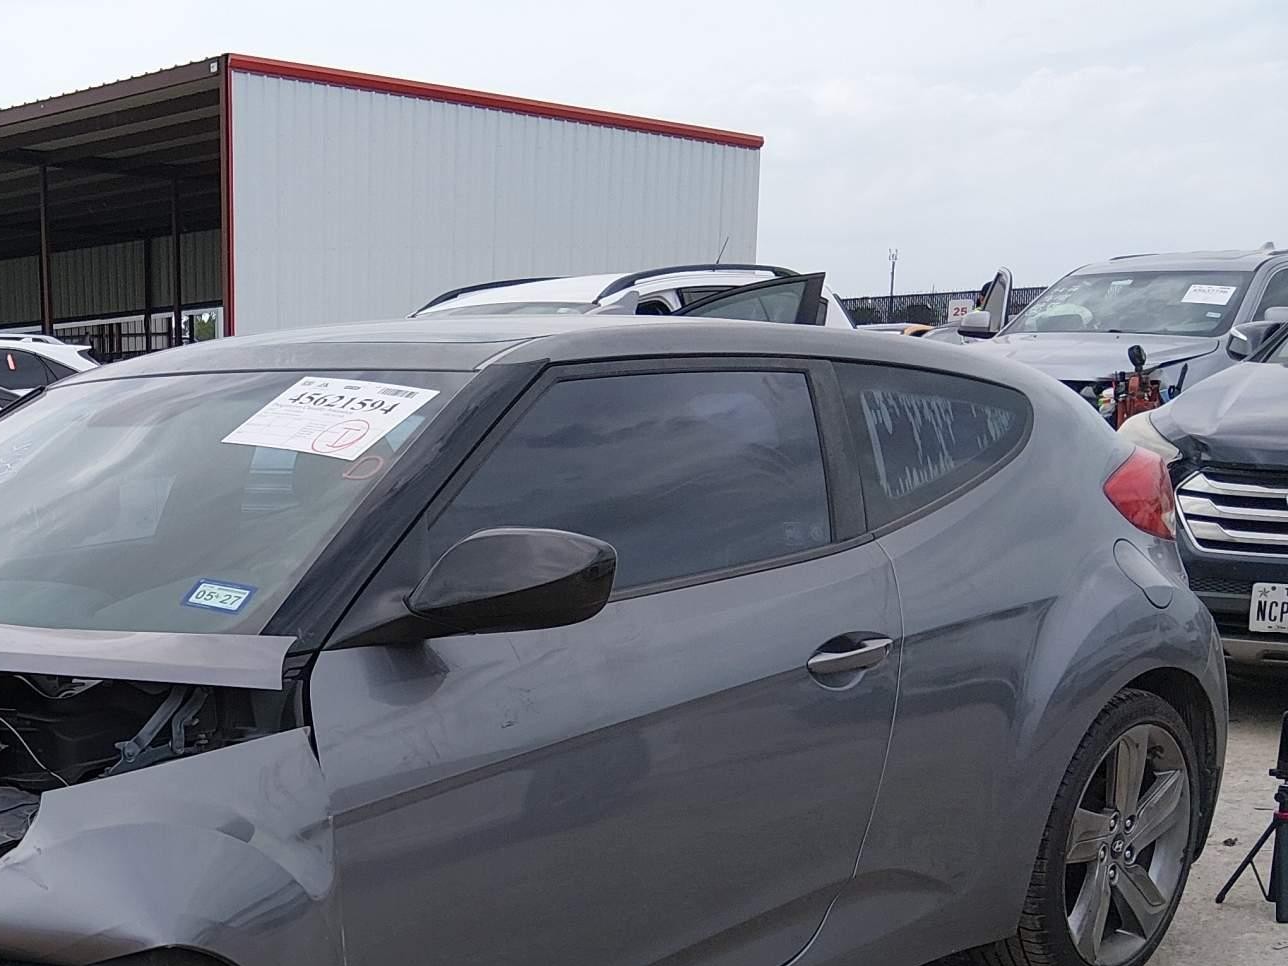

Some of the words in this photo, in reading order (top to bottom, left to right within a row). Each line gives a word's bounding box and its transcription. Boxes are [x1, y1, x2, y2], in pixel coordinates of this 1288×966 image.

[953, 307, 968, 317] 25
[289, 391, 400, 414] 45621594
[195, 590, 216, 601] 05
[219, 594, 242, 605] 27
